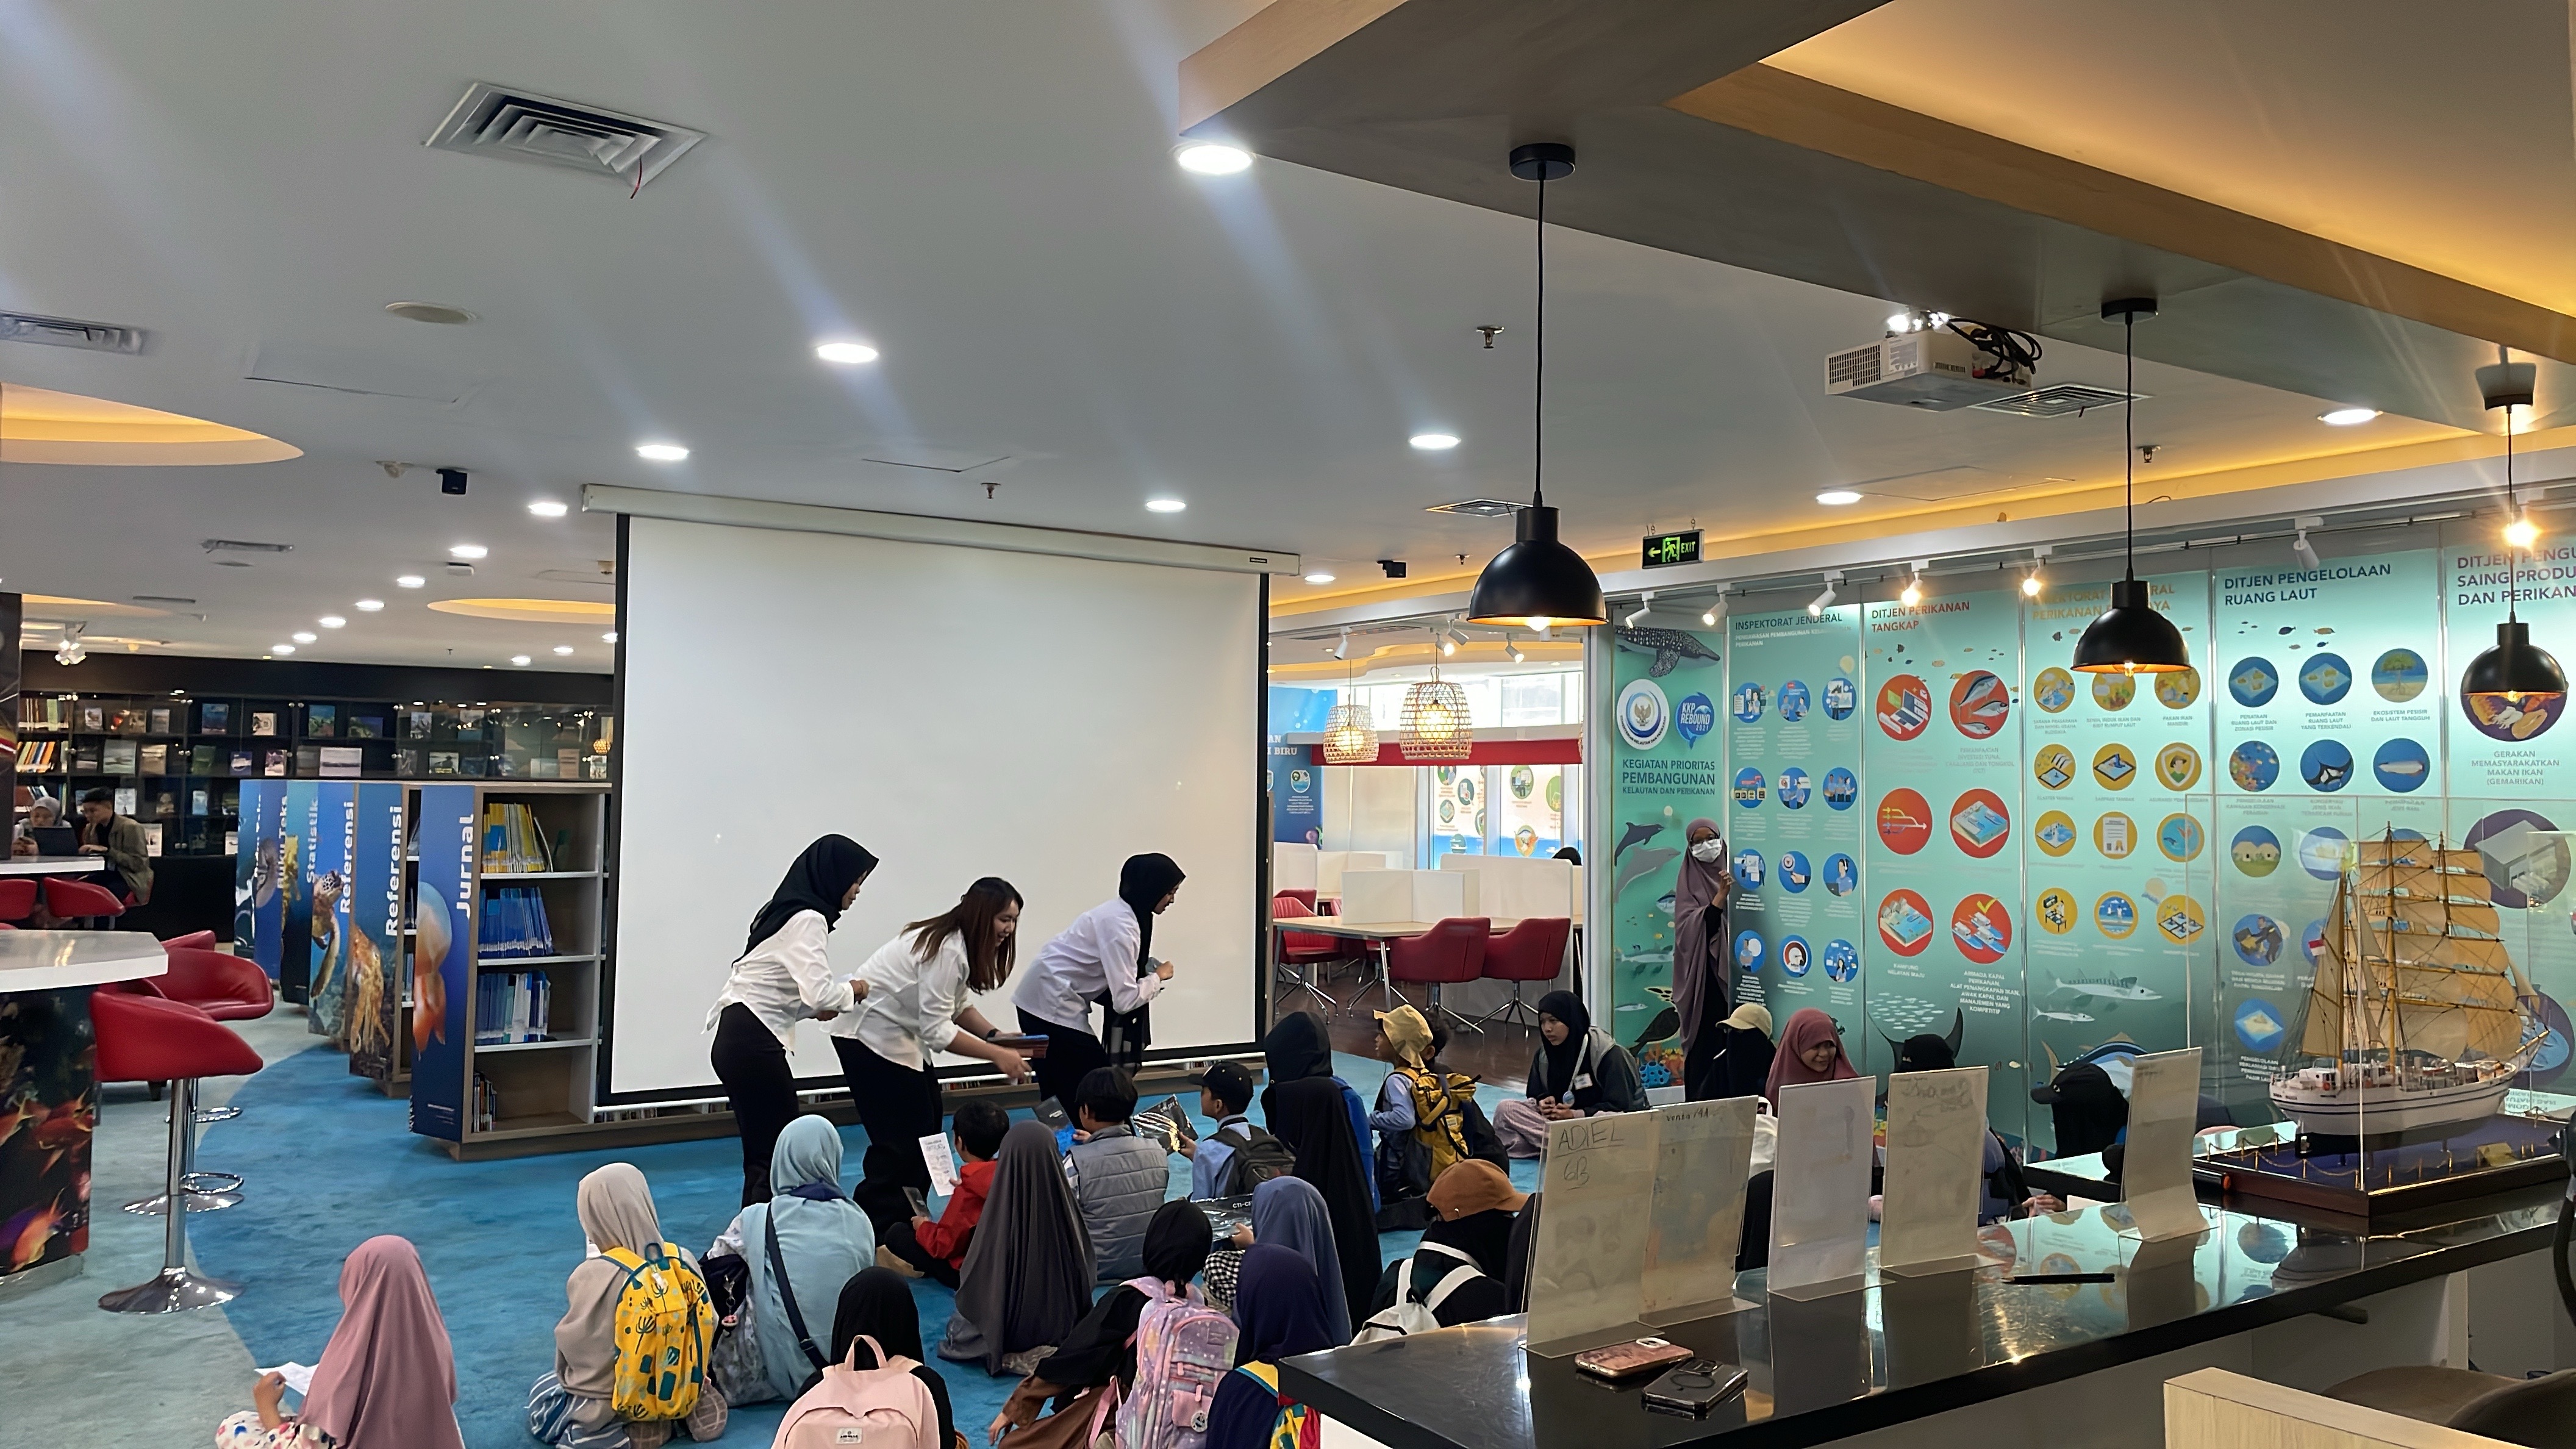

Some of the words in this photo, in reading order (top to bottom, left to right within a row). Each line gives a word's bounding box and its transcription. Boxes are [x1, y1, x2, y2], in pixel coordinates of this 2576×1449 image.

[1681, 541, 1696, 554] EXIT
[2225, 574, 2273, 589] DITJEN
[2278, 564, 2391, 584] PENGELOLAAN
[2457, 571, 2510, 587] SAING
[2225, 592, 2275, 606] RUANG
[2280, 588, 2318, 601] LAUT
[2458, 592, 2495, 606] DAN
[1872, 607, 1906, 619] DITJEN
[1909, 601, 1970, 616] PERIKANAN
[2033, 606, 2102, 620] PERIKANAN
[1735, 617, 1794, 631] INSPEKTORAT
[1795, 613, 1843, 625] JENDERAL
[1872, 620, 1919, 632] TANGKAP
[1681, 702, 1696, 713] KKP
[1680, 712, 1711, 725] REBOUND
[1274, 746, 1298, 756] BIRU
[1622, 759, 1668, 769] KEGIATAN
[1670, 760, 1715, 770] PRIORITAS
[1622, 771, 1715, 785] PEMBANGUNAN
[340, 801, 354, 914] Referensi
[385, 806, 402, 936] Referensi
[456, 813, 474, 920] Jurnal
[1558, 1118, 1625, 1151] ADIEL
